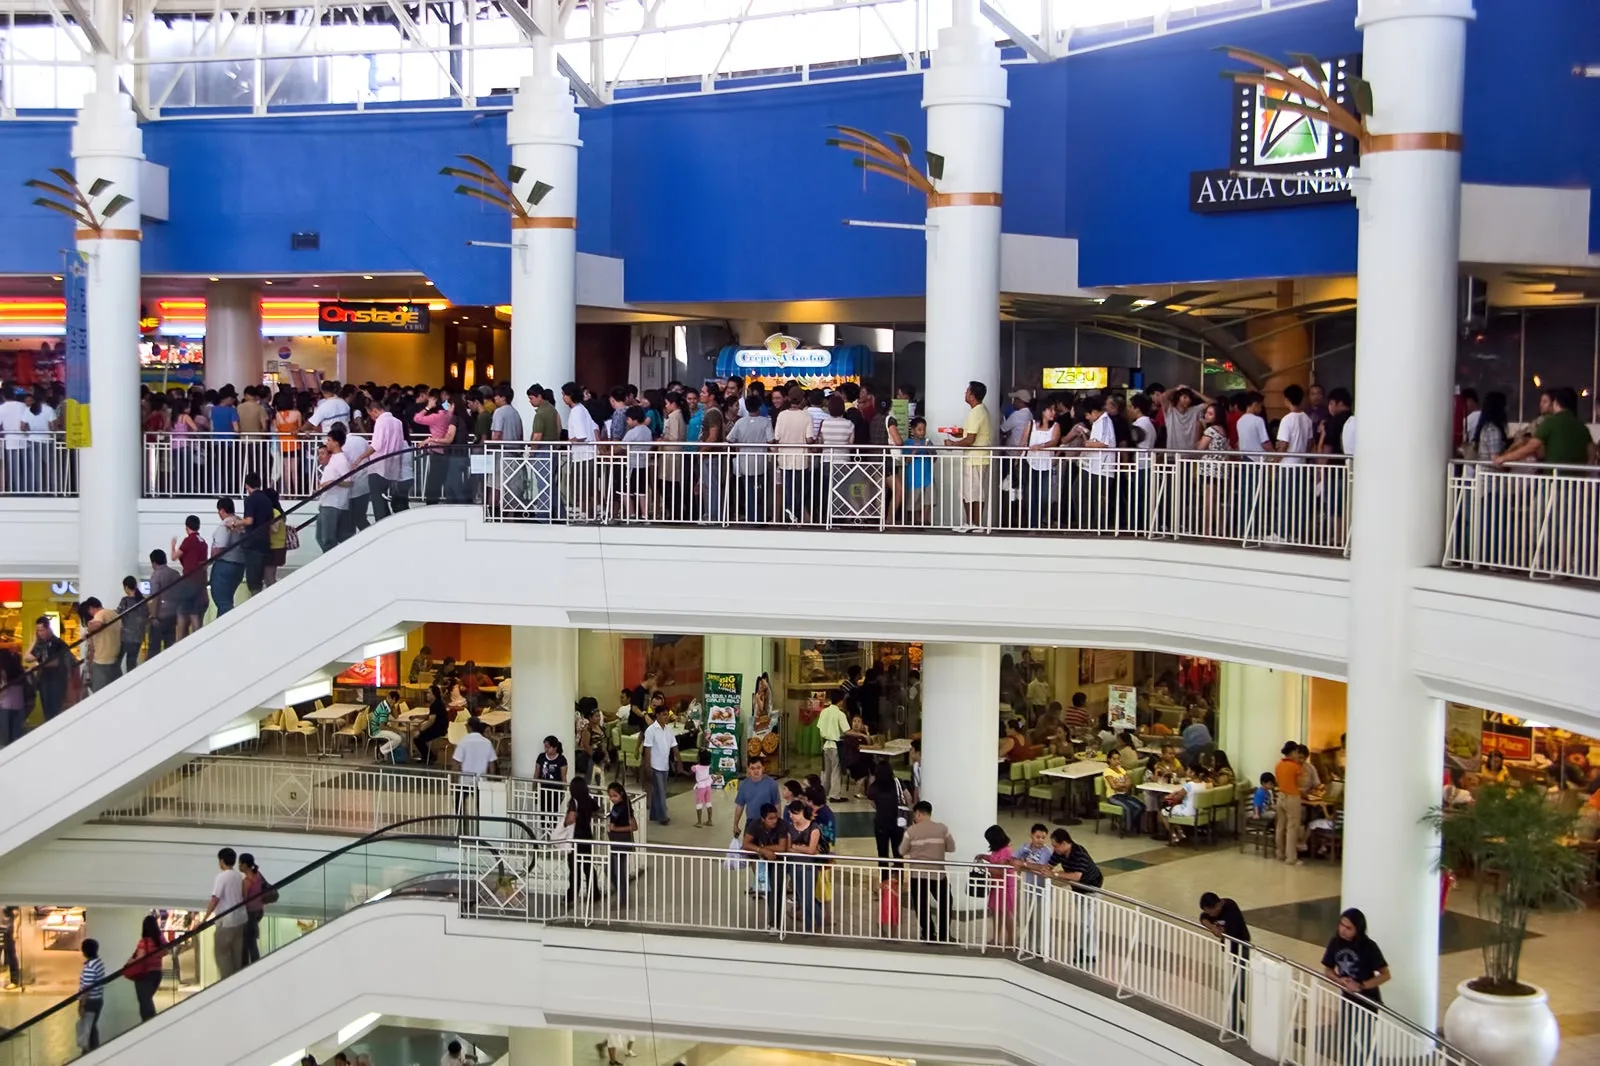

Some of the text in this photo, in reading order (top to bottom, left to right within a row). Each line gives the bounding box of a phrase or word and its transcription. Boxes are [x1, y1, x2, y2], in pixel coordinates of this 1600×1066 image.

[1197, 176, 1276, 203] AYALA
[321, 306, 419, 326] Onstage
[1055, 370, 1096, 384] Zagu
